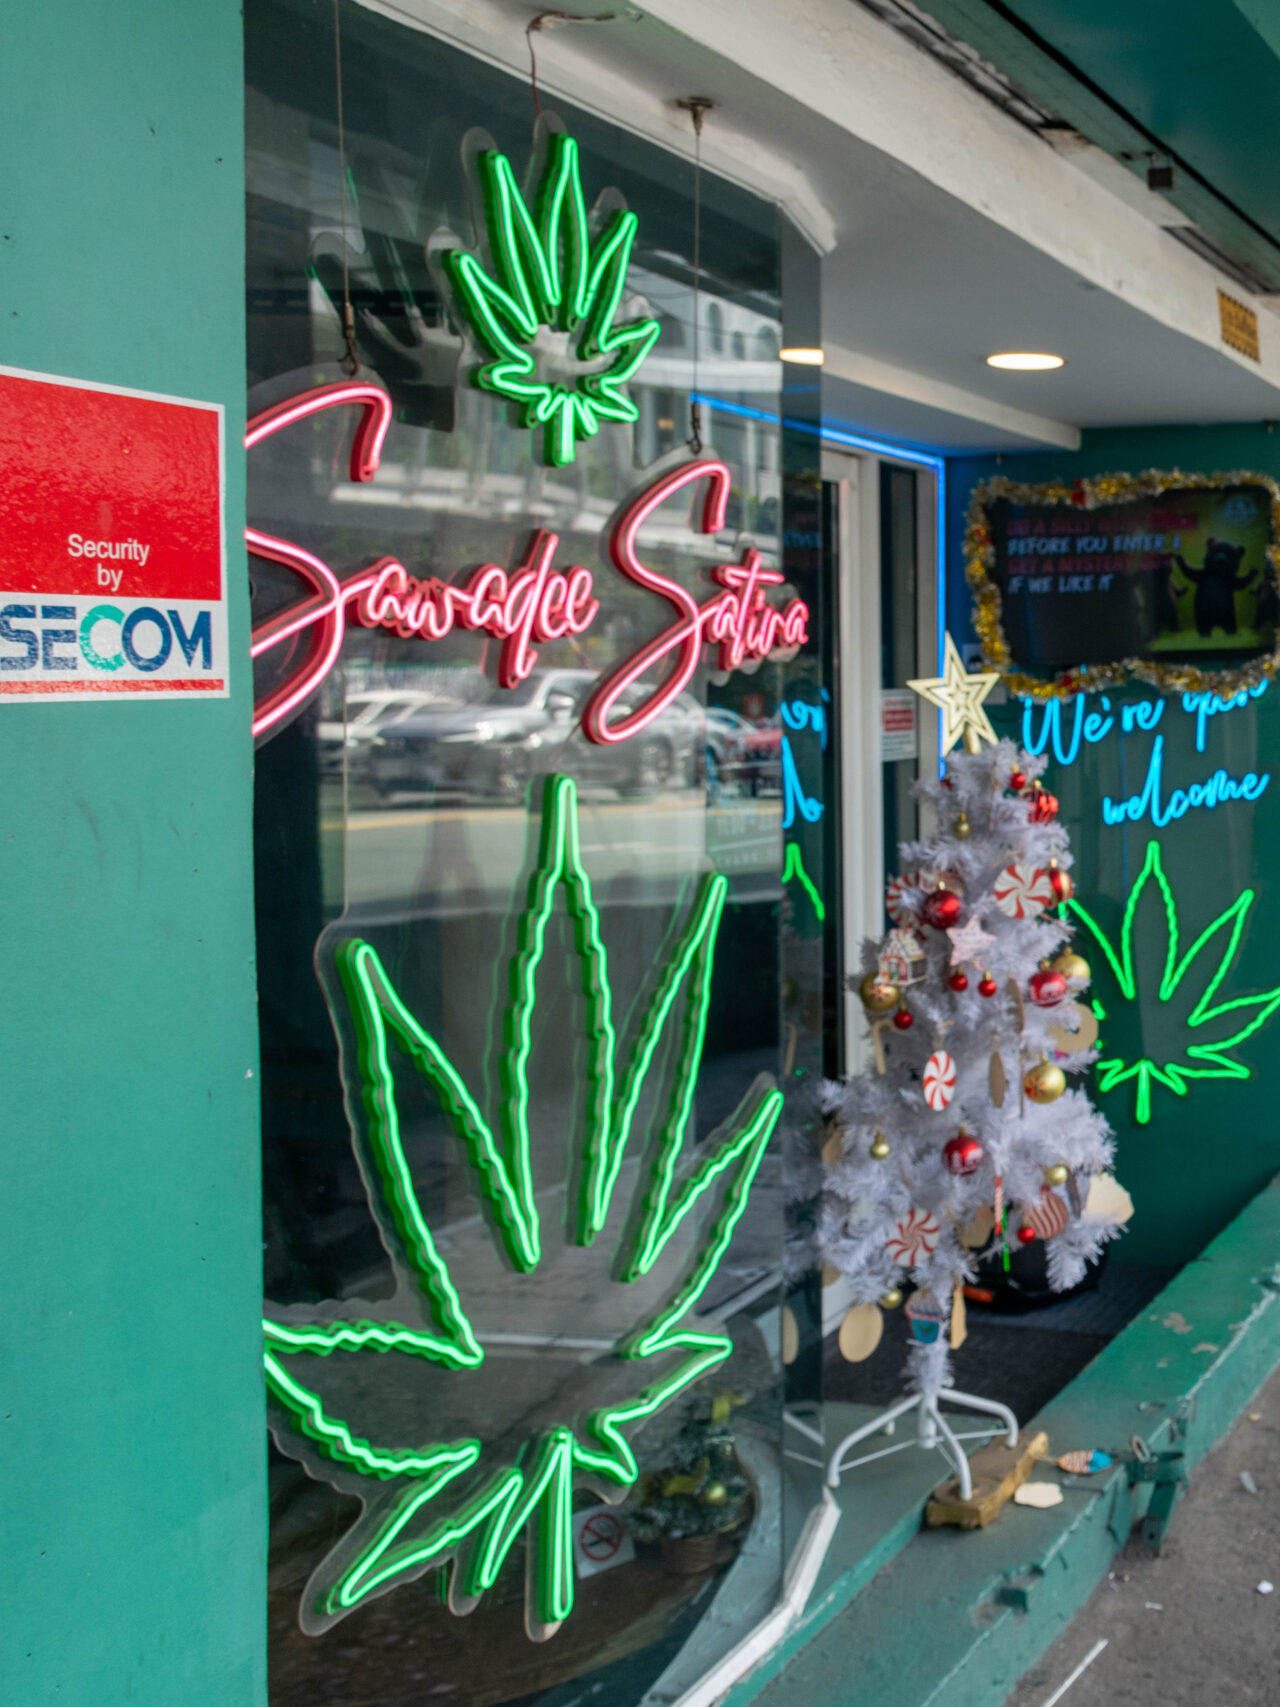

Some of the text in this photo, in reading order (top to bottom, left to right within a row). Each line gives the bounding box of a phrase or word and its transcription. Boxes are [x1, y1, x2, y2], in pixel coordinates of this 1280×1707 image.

[68, 534, 150, 566] Security
[1008, 537, 1070, 555] BEFORE
[1076, 535, 1107, 553] YOU
[1113, 533, 1165, 551] ENTER
[97, 563, 124, 591] by
[1028, 575, 1053, 591] WE
[1059, 574, 1093, 592] LIKE
[0, 603, 212, 673] SECOM
[1021, 692, 1166, 766] We're
[1103, 734, 1270, 827] welcome
